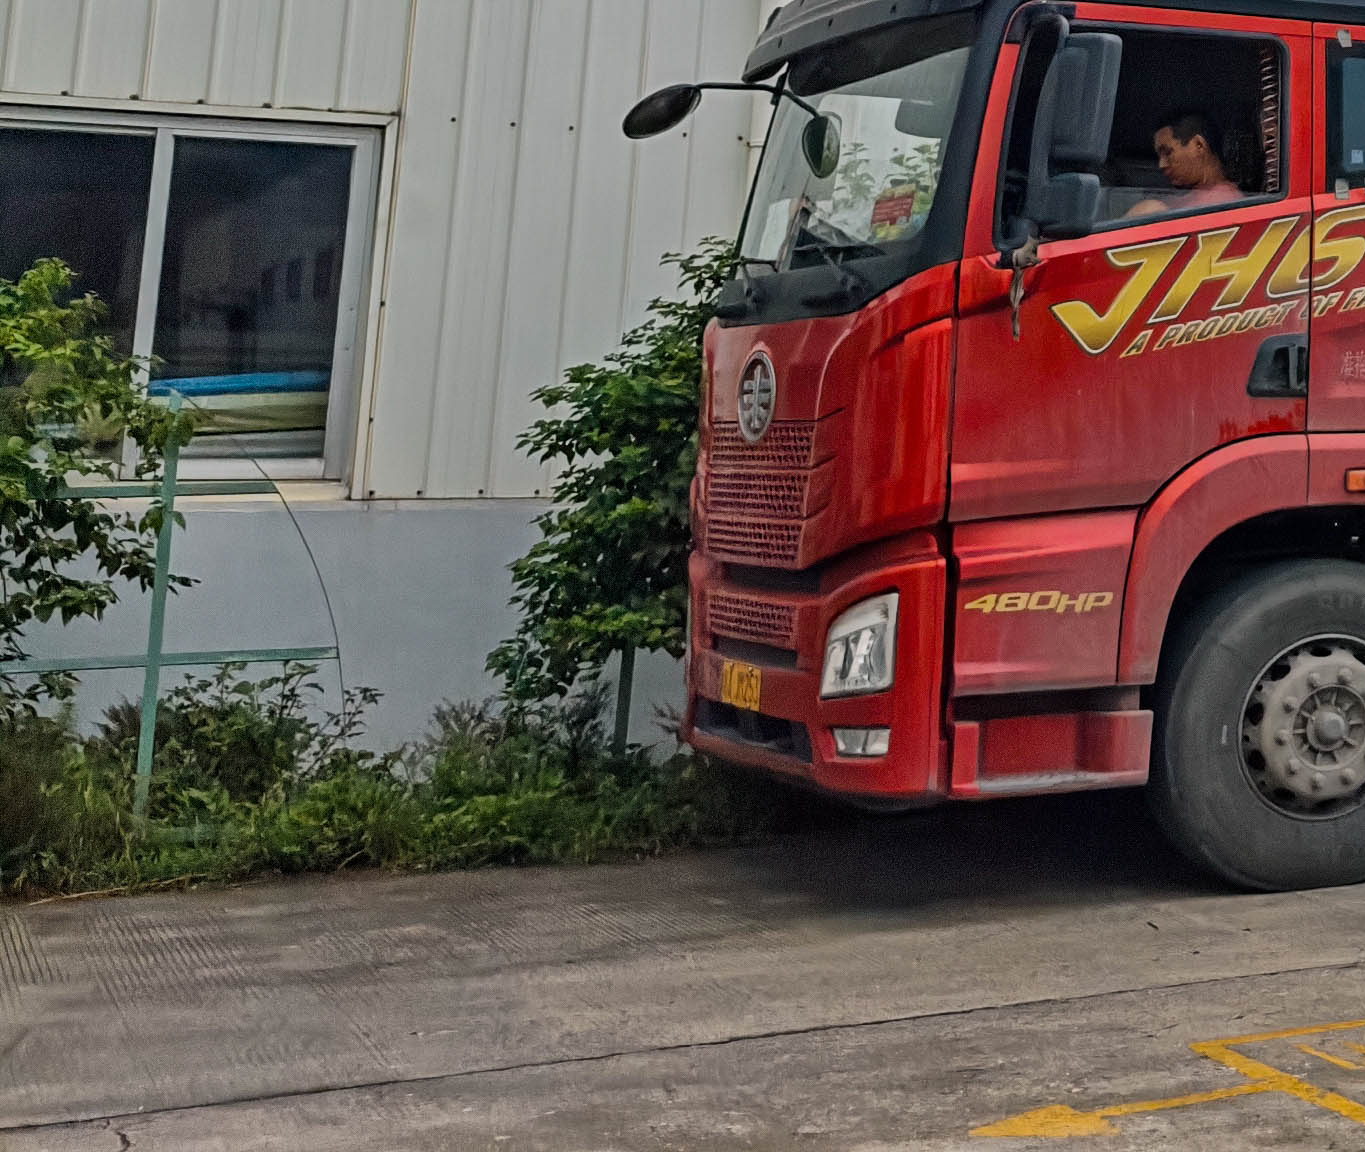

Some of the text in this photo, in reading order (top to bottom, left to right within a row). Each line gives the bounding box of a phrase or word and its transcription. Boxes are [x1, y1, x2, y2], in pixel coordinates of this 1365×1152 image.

[1119, 329, 1153, 359] A
[1153, 301, 1297, 352] PRODUCT
[1298, 292, 1337, 319] OF
